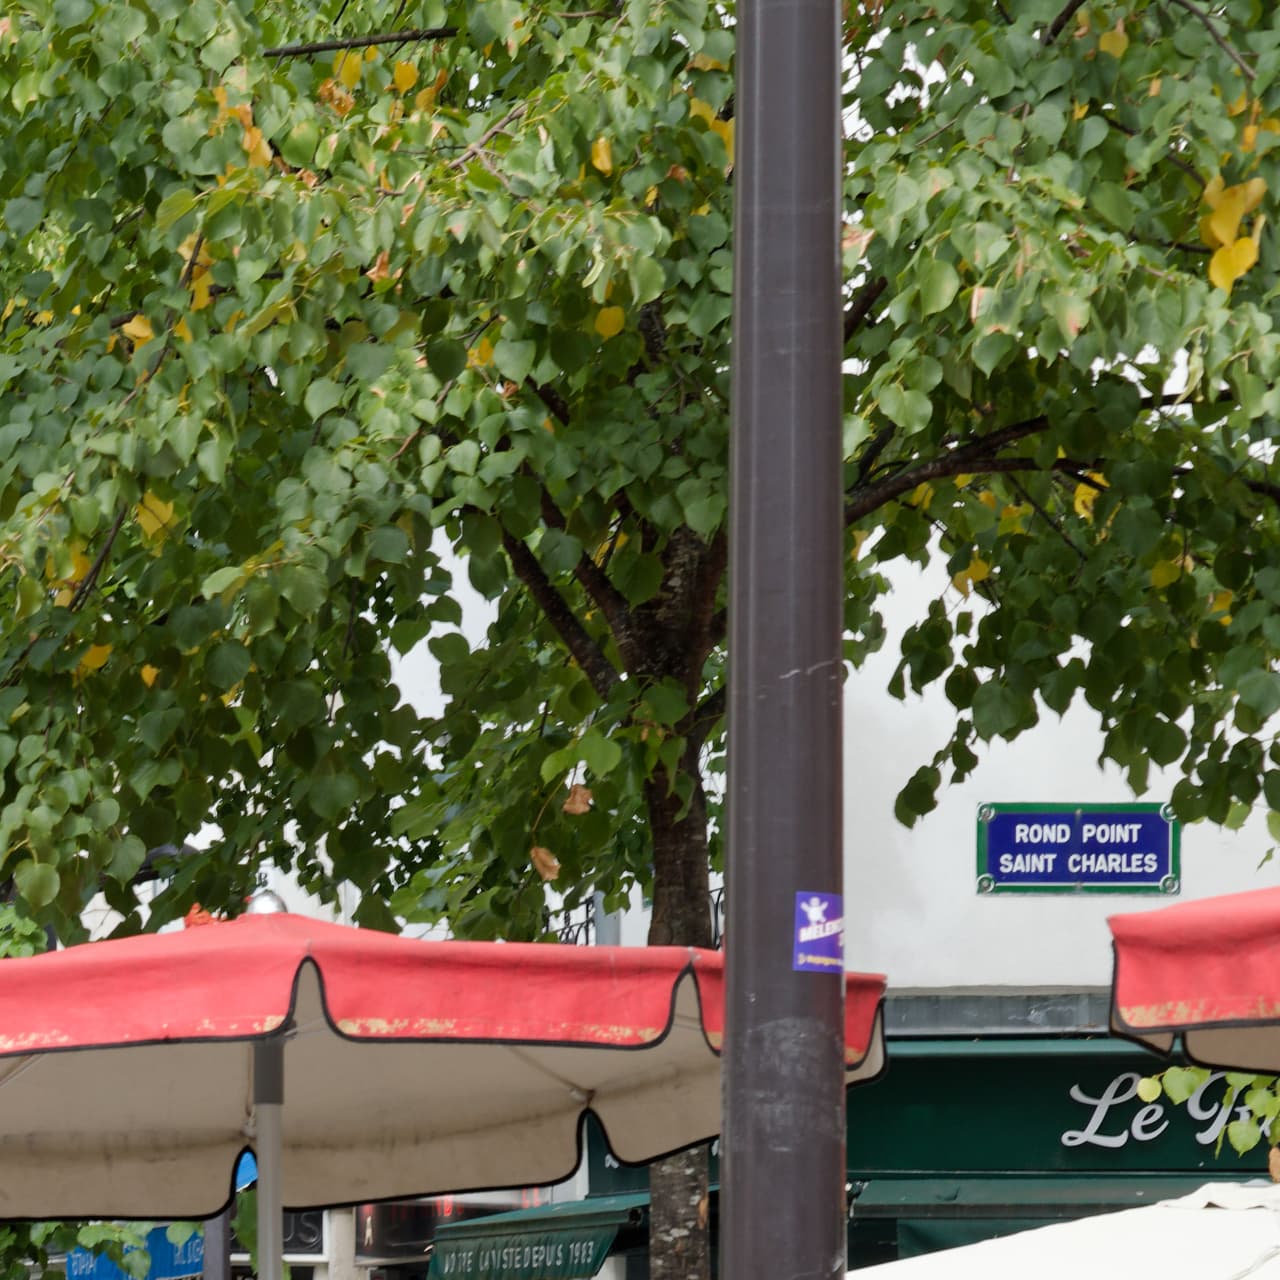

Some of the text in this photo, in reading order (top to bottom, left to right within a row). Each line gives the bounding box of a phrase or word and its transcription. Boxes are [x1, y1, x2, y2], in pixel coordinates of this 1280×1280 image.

[1015, 824, 1142, 843] ROND POINT
[1000, 853, 1158, 873] SAINT CHARLES
[1061, 1072, 1170, 1148] Le
[569, 1240, 595, 1265] 1983
